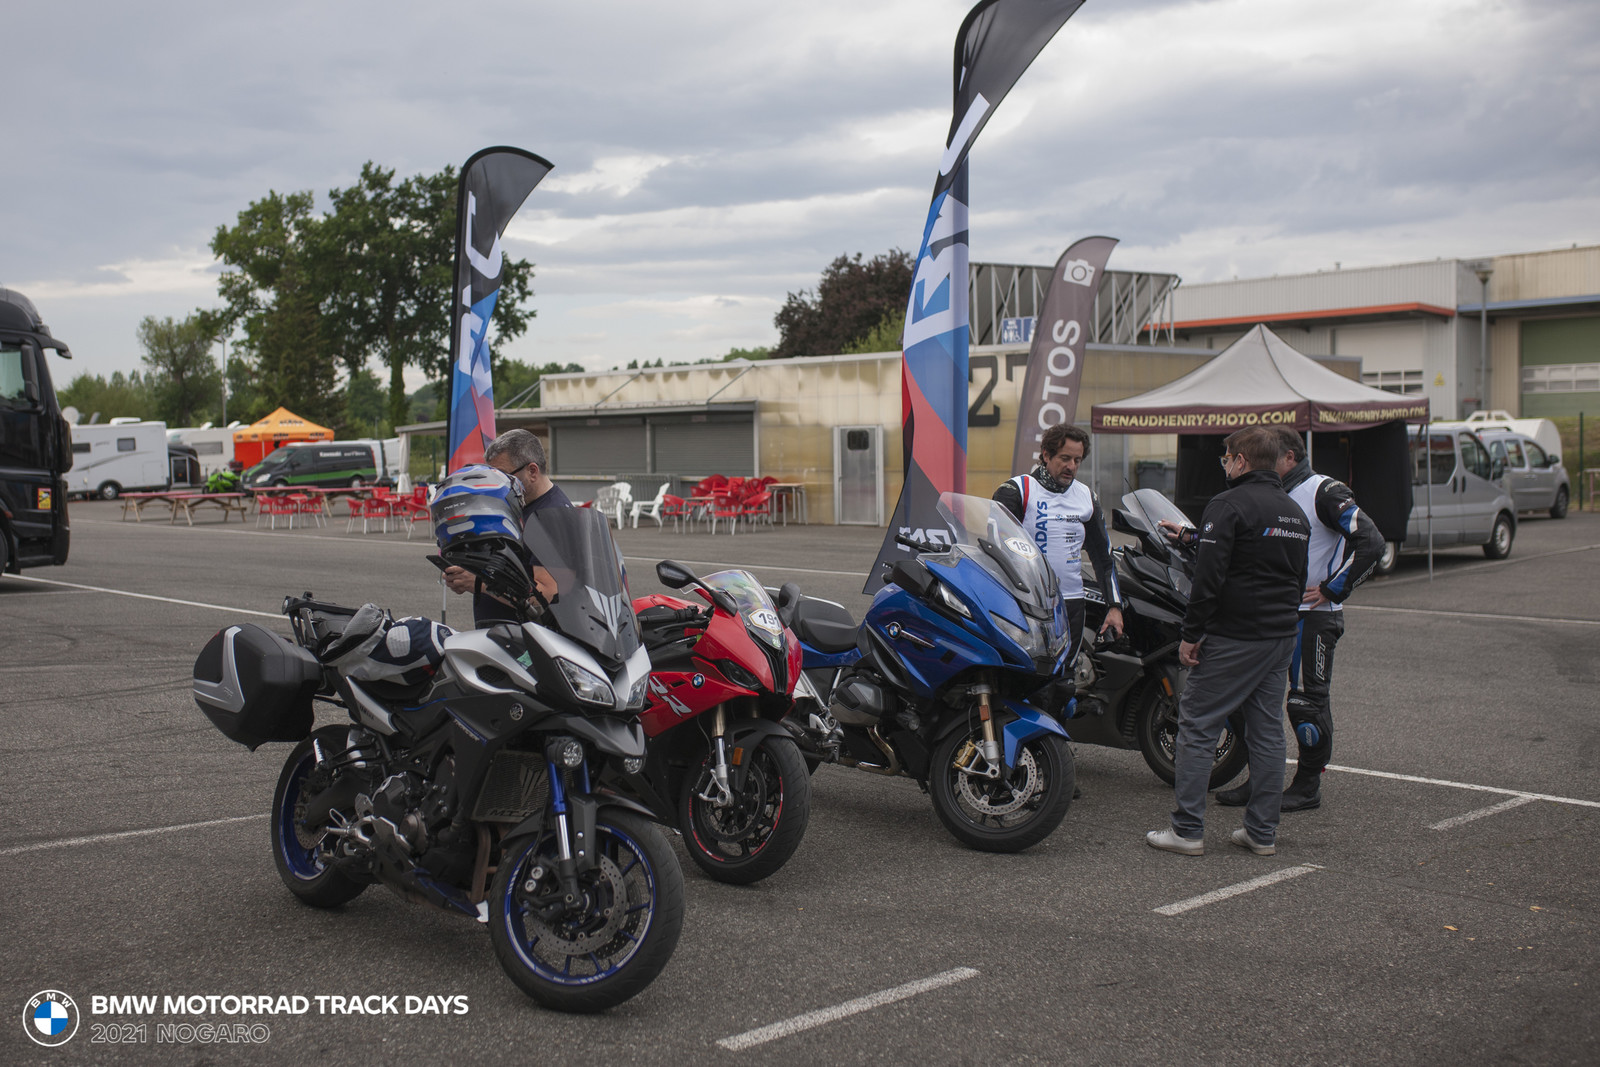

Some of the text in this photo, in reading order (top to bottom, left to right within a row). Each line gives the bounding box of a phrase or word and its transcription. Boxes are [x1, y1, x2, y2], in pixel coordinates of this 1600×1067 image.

[1030, 319, 1082, 475] OTOS
[1102, 410, 1297, 428] RENAUDHENRY-PHOTO.COM
[1035, 502, 1047, 554] KDAYS
[758, 612, 780, 629] 191
[1315, 633, 1327, 681] RST
